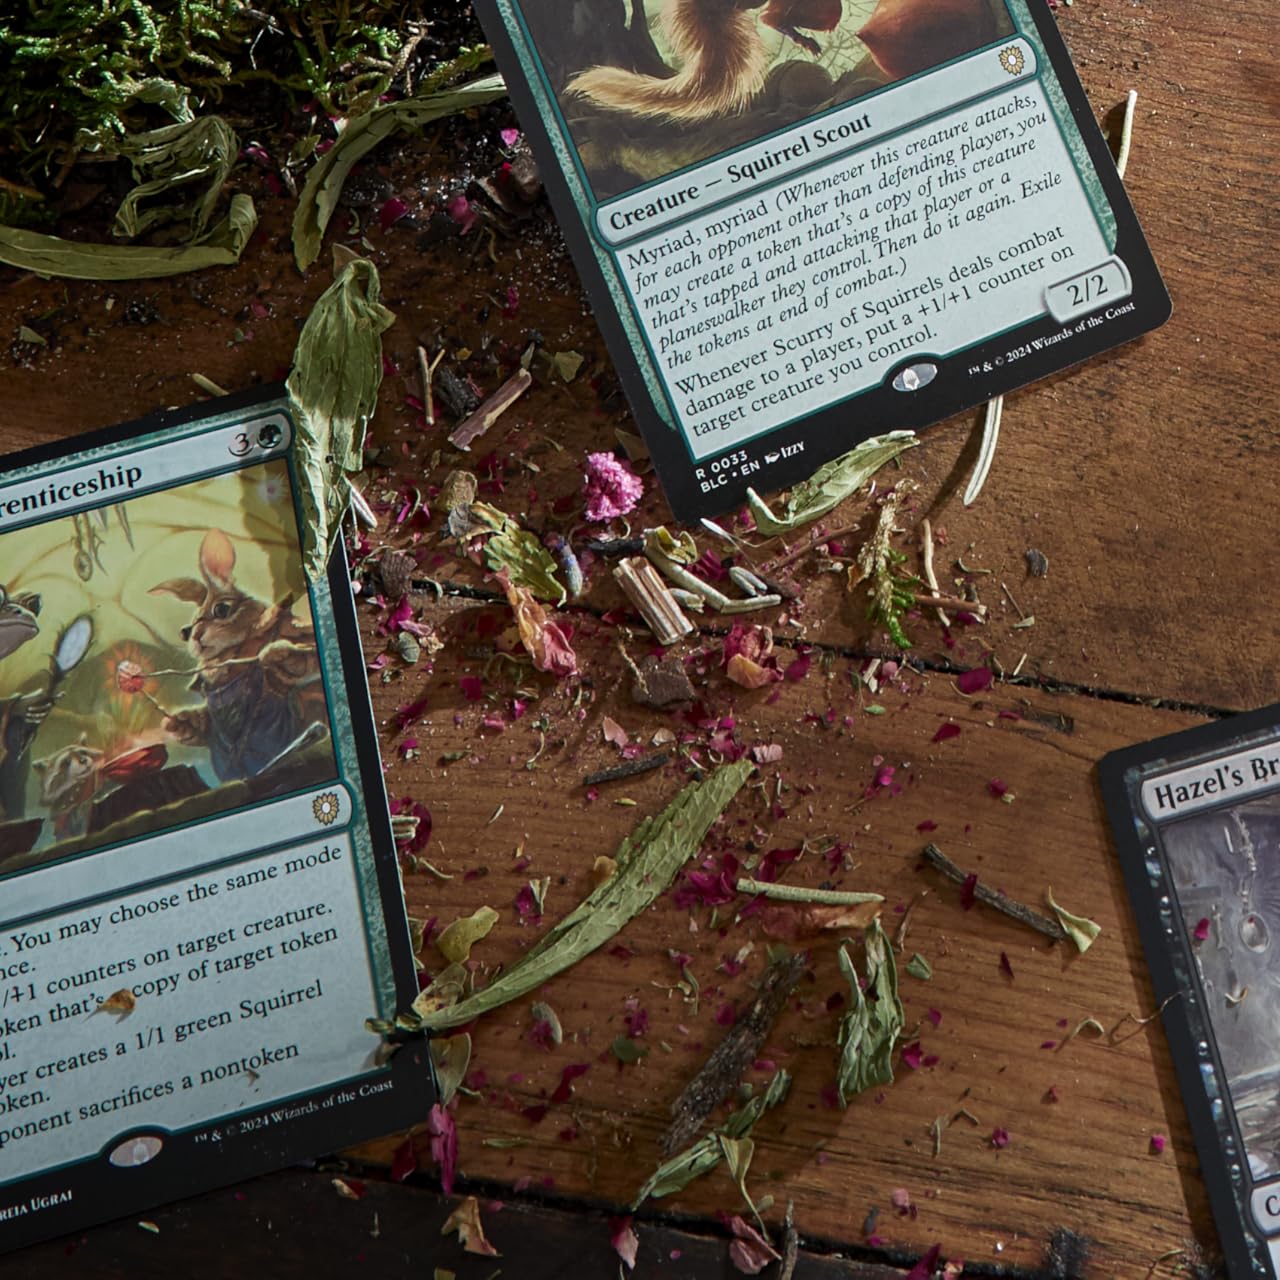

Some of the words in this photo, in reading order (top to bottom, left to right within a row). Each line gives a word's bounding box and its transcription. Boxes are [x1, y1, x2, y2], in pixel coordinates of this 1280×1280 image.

[610, 186, 700, 230] Creature
[727, 135, 811, 183] Squirrel
[813, 113, 871, 148] Scout
[674, 349, 768, 395] Whenever
[772, 322, 833, 356] Scurry
[840, 306, 859, 328] of
[861, 276, 944, 319] Squirrels
[948, 255, 994, 283] deals
[998, 226, 1064, 262] combat
[1066, 274, 1108, 306] 2/2
[1005, 343, 1032, 362] 2024
[1030, 327, 1073, 350] Wizards
[1074, 319, 1086, 333] of
[1086, 315, 1104, 328] the
[1105, 301, 1136, 320] Coast
[695, 467, 706, 480] R
[710, 449, 748, 473] 0033
[700, 473, 728, 493] BLC
[740, 459, 760, 476] EN
[780, 441, 804, 458] IZZY
[1154, 764, 1244, 809] Hazel's
[9, 931, 51, 952] You
[58, 915, 102, 940] may
[109, 894, 180, 924] choose
[186, 883, 219, 902] the
[225, 866, 278, 891] same
[284, 845, 342, 874] mode
[46, 958, 136, 994] counters
[143, 948, 170, 966] on
[176, 927, 236, 957] target
[242, 903, 332, 937] creature.
